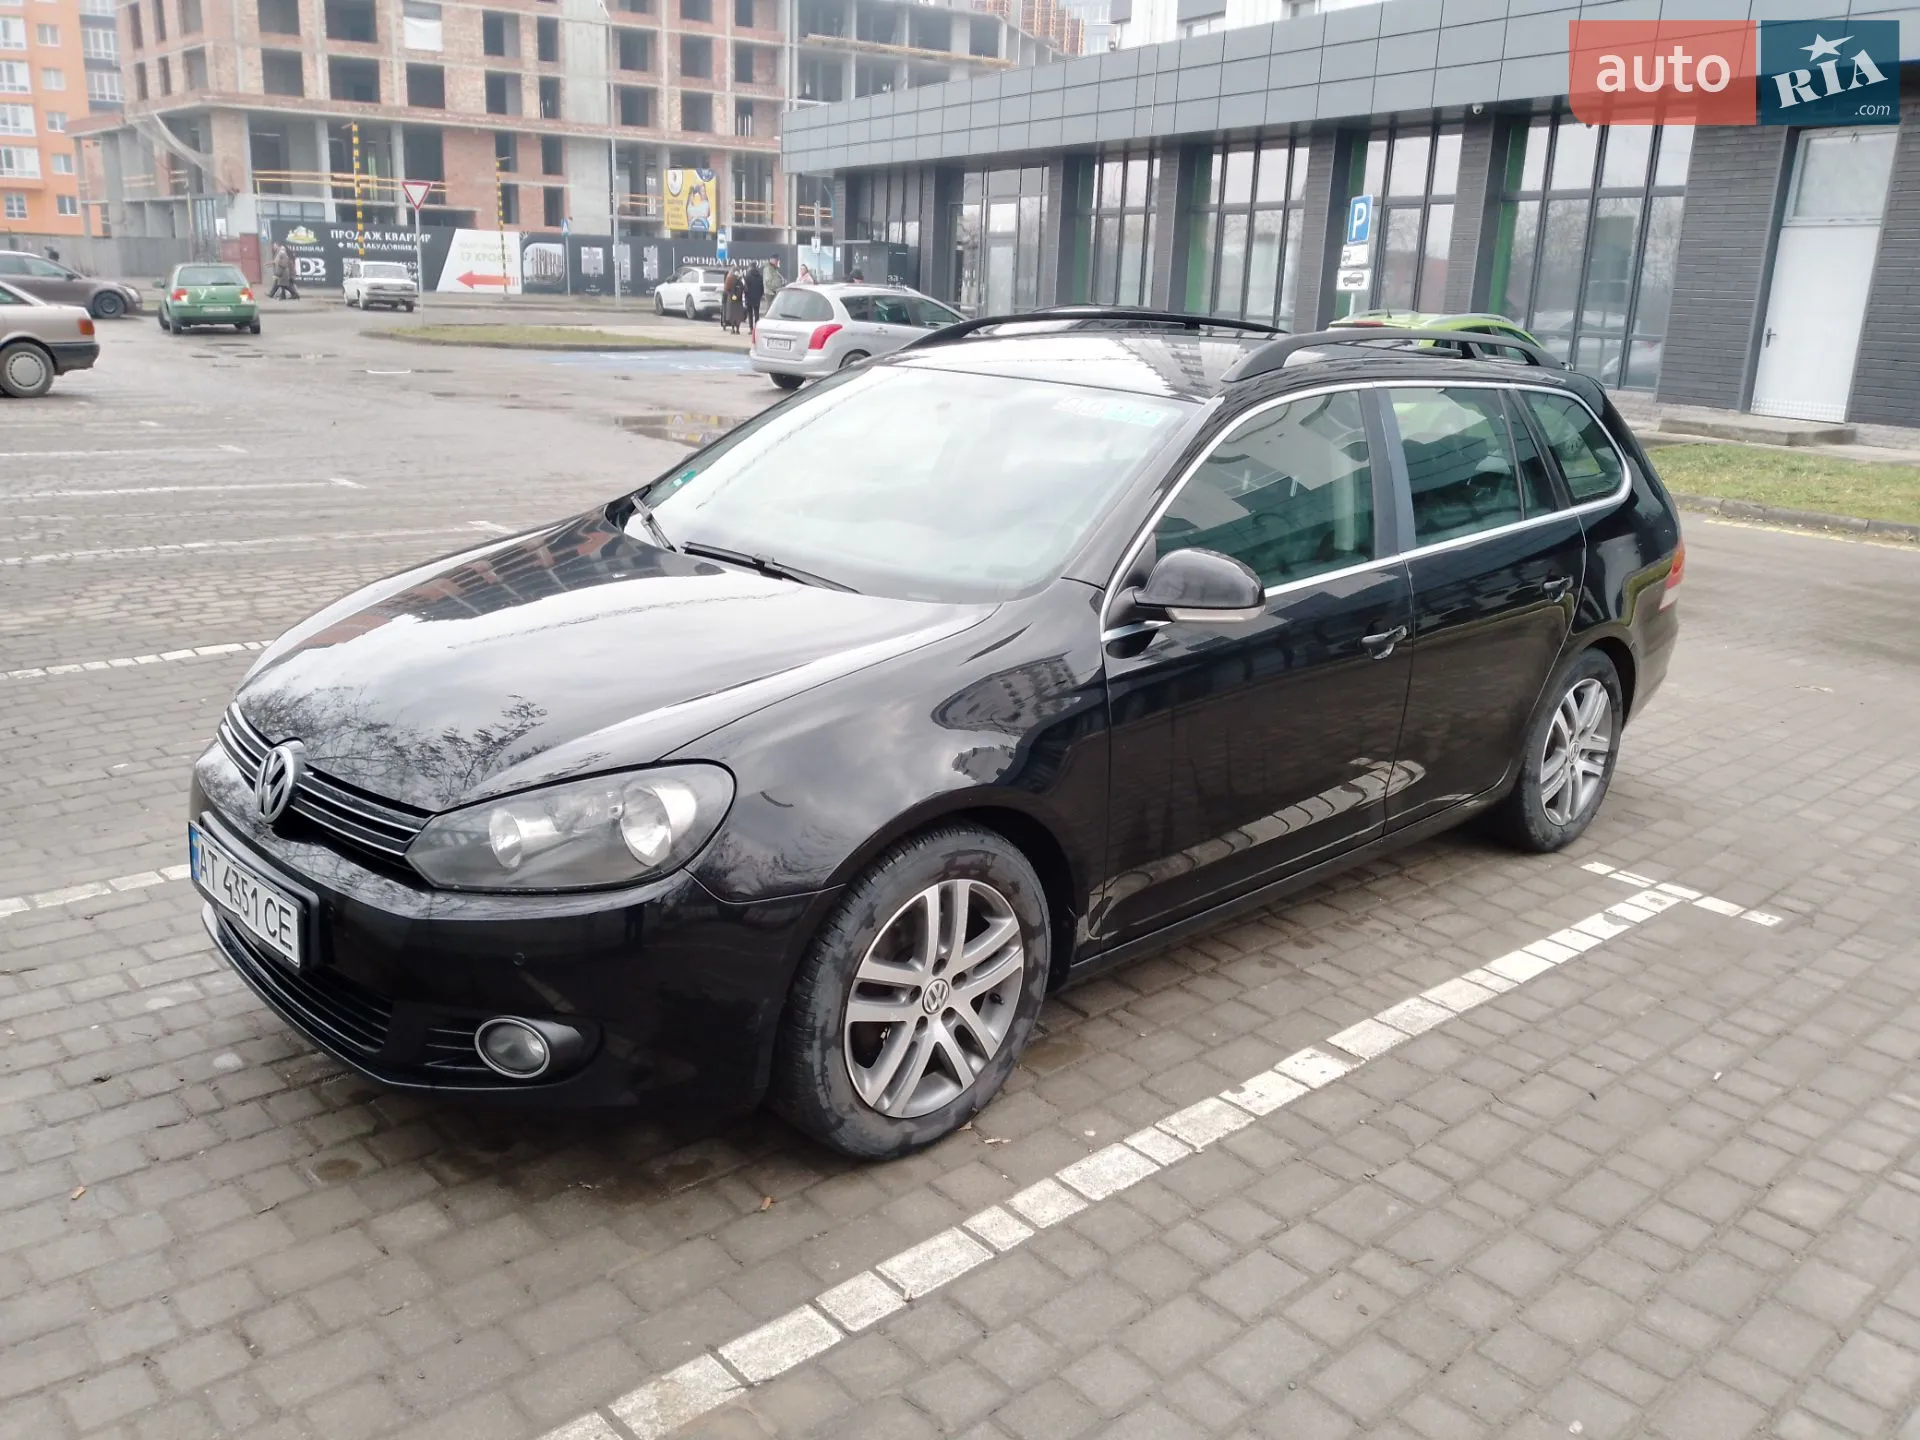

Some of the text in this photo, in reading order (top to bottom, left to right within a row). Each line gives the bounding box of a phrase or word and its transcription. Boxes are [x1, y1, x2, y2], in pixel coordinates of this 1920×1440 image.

[1352, 202, 1367, 239] P
[223, 864, 259, 927] 4351
[264, 897, 293, 951] CE
